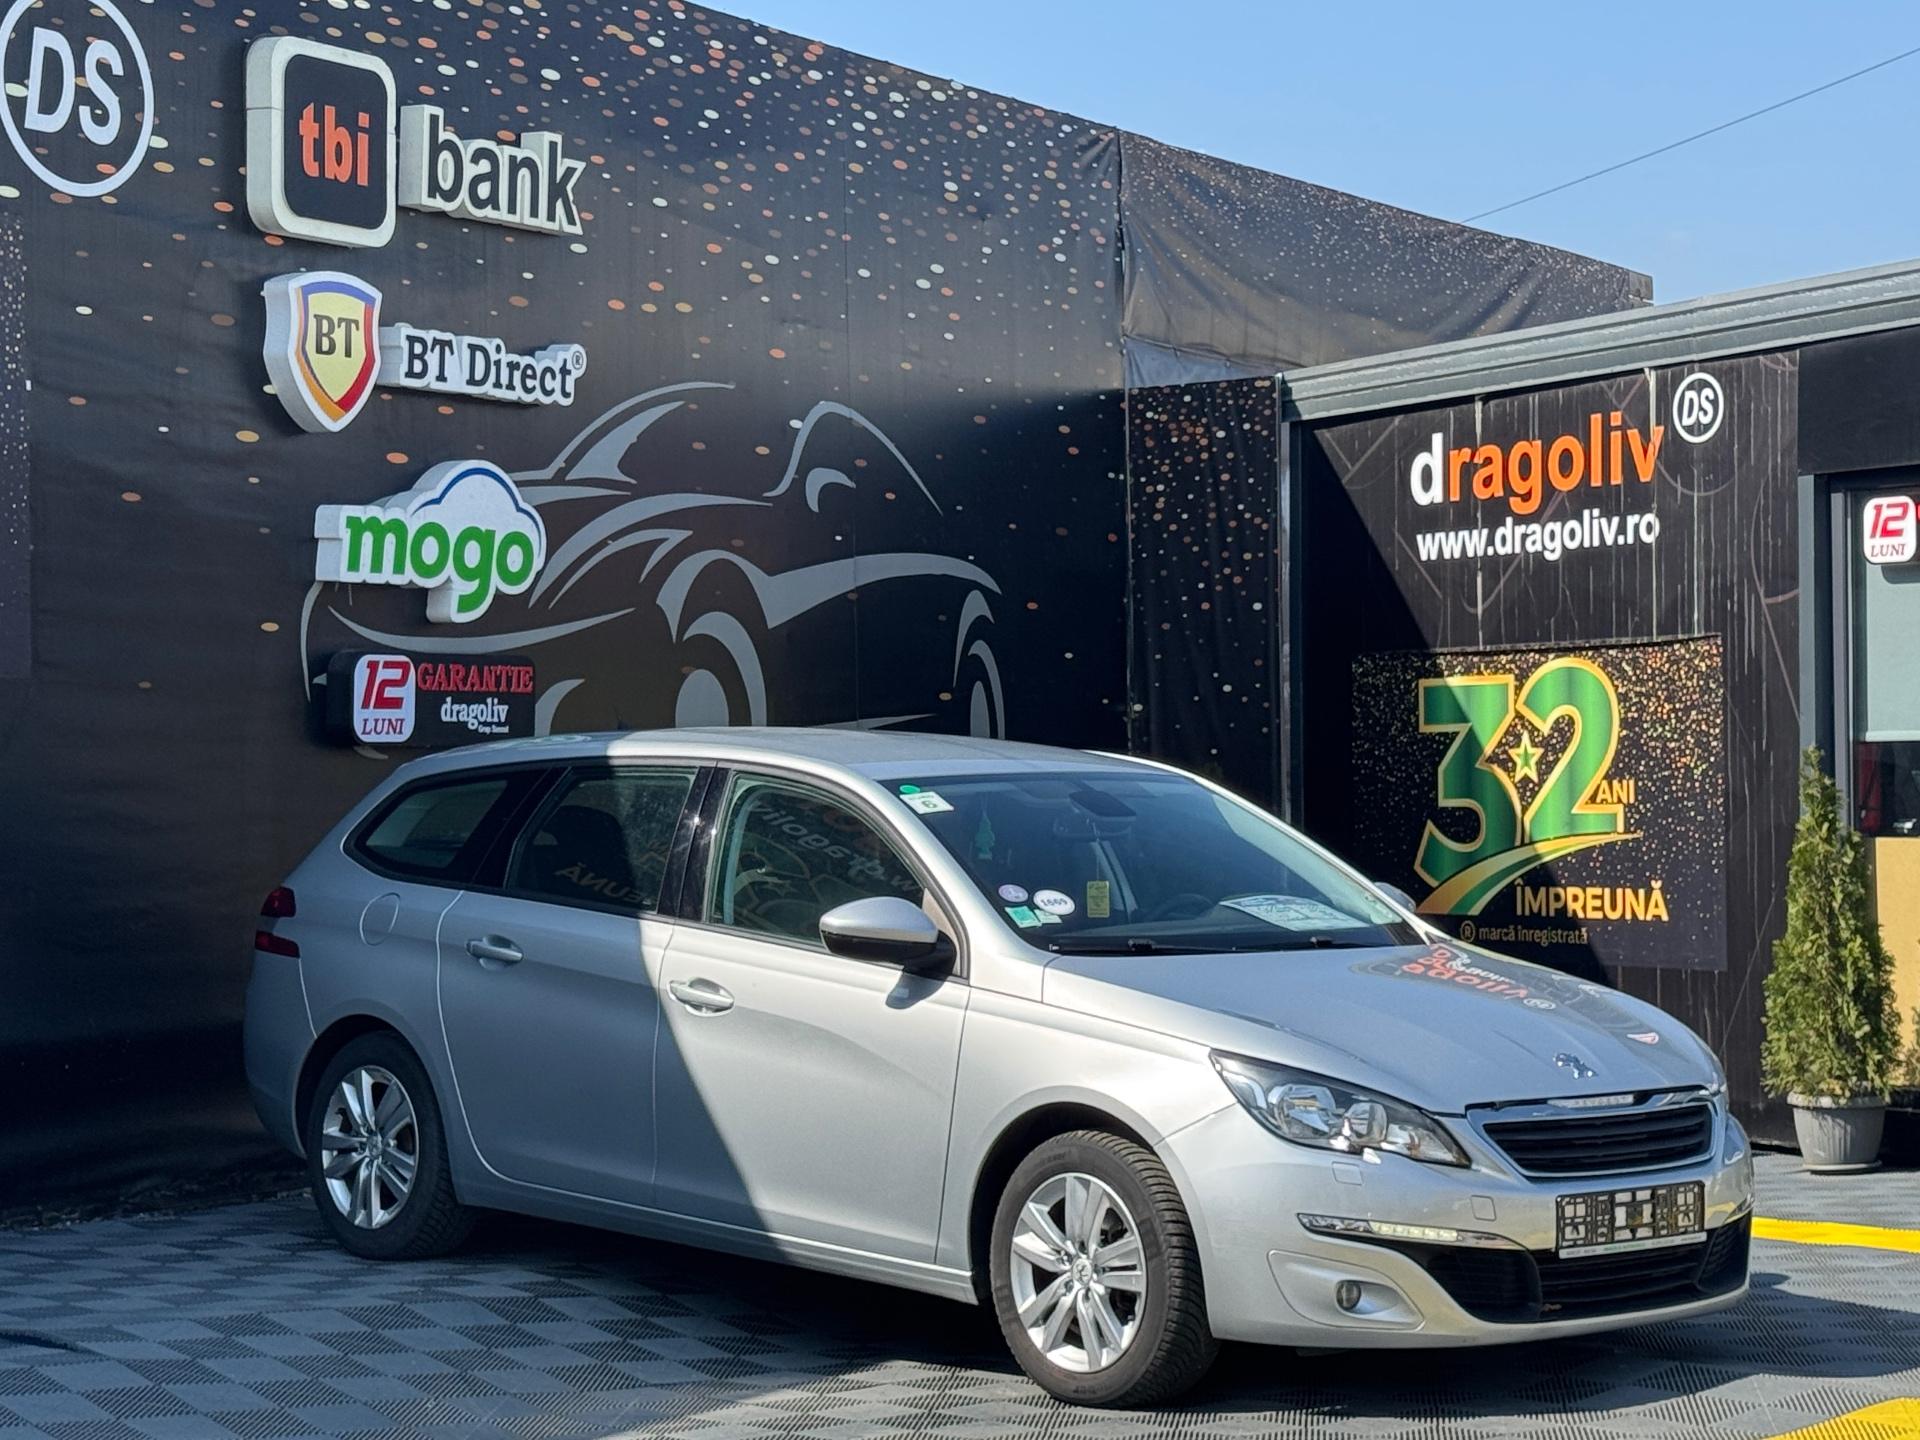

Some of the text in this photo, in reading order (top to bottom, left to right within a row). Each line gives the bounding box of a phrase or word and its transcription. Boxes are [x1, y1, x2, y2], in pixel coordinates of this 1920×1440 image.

[24, 27, 124, 146] DS
[299, 102, 584, 229] tbi bank
[313, 314, 360, 358] BT
[405, 334, 454, 382] BT
[1682, 387, 1715, 427] DS
[1410, 411, 1665, 515] dragoliv
[1416, 508, 1660, 561] www.dragoliv.ro
[1869, 502, 1909, 539] 12
[345, 515, 534, 613] mogo
[1871, 543, 1906, 557] LUNI
[361, 660, 412, 710] 12
[417, 662, 534, 694] GARANTIE
[361, 718, 405, 735] LUNI
[440, 696, 509, 730] dragoliv
[1413, 656, 1626, 888] 32
[1596, 779, 1635, 804] ANI
[1514, 880, 1669, 921] ÎMPREUNĂ
[1479, 925, 1515, 941] marcă
[1517, 925, 1588, 947] înregistrată
